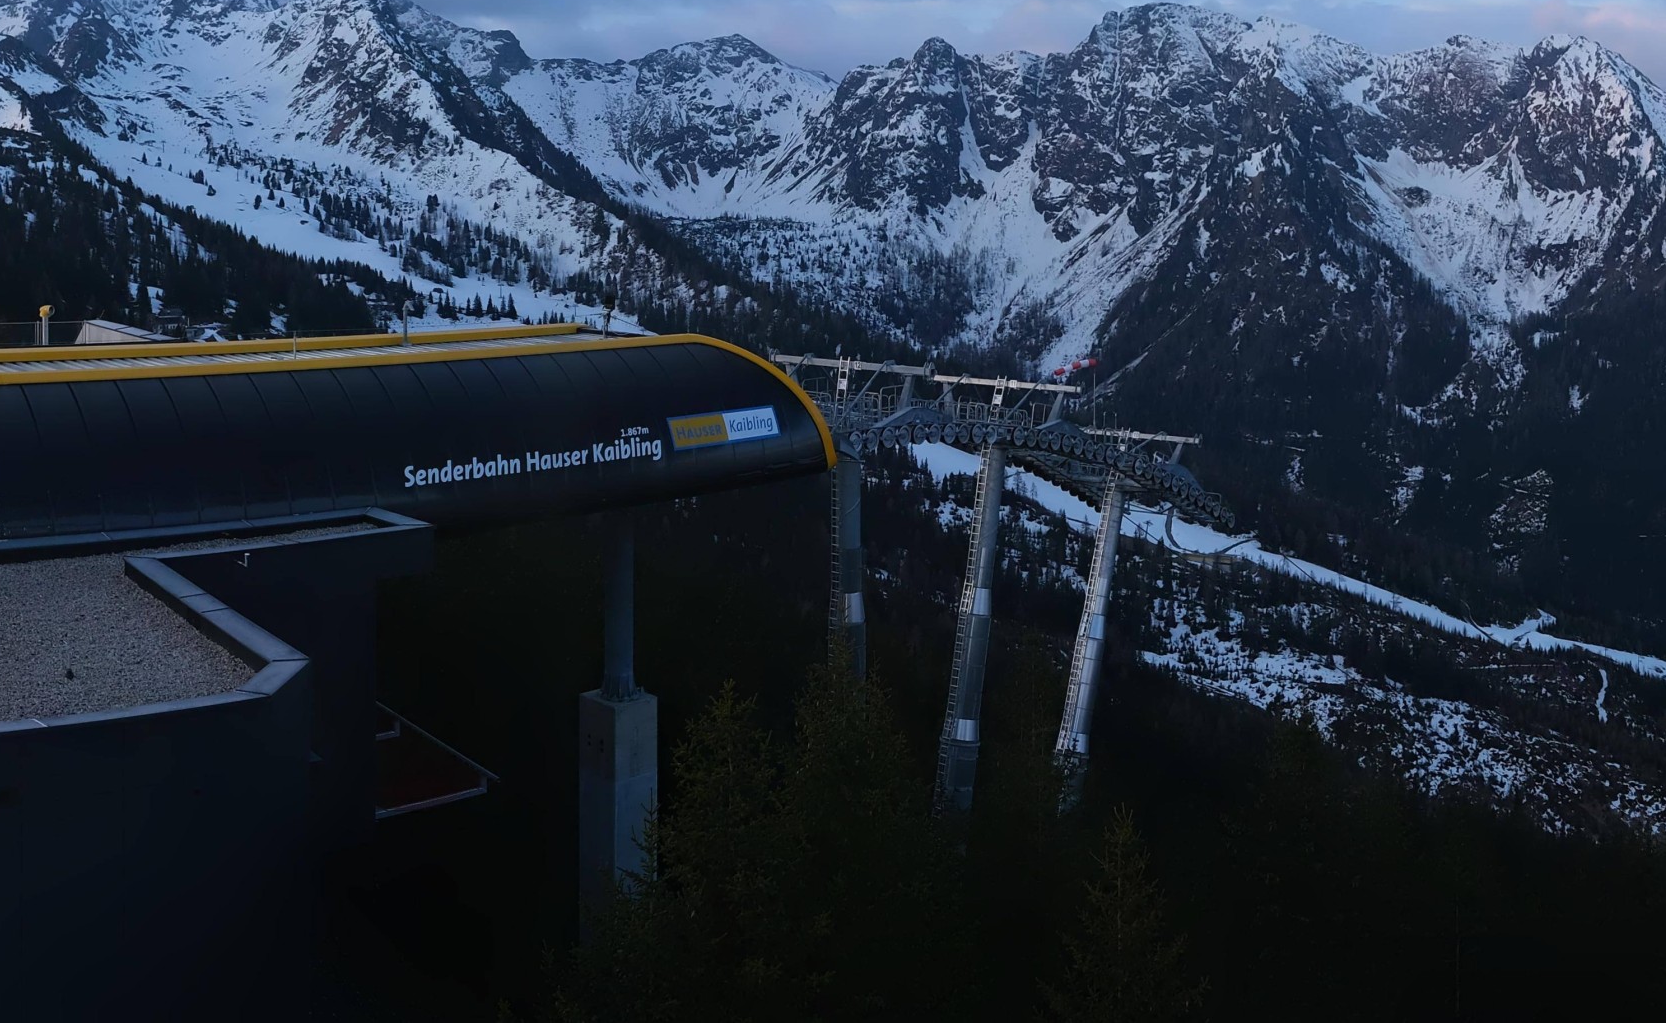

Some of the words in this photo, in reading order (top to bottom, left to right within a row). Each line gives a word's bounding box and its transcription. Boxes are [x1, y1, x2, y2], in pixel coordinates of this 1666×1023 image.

[620, 426, 649, 437] 1.867m
[676, 425, 722, 440] HAUSER
[729, 416, 773, 433] Kaibling
[404, 454, 521, 487] Senderbahn
[526, 448, 589, 472] Hauser
[592, 437, 662, 461] Kaibling
